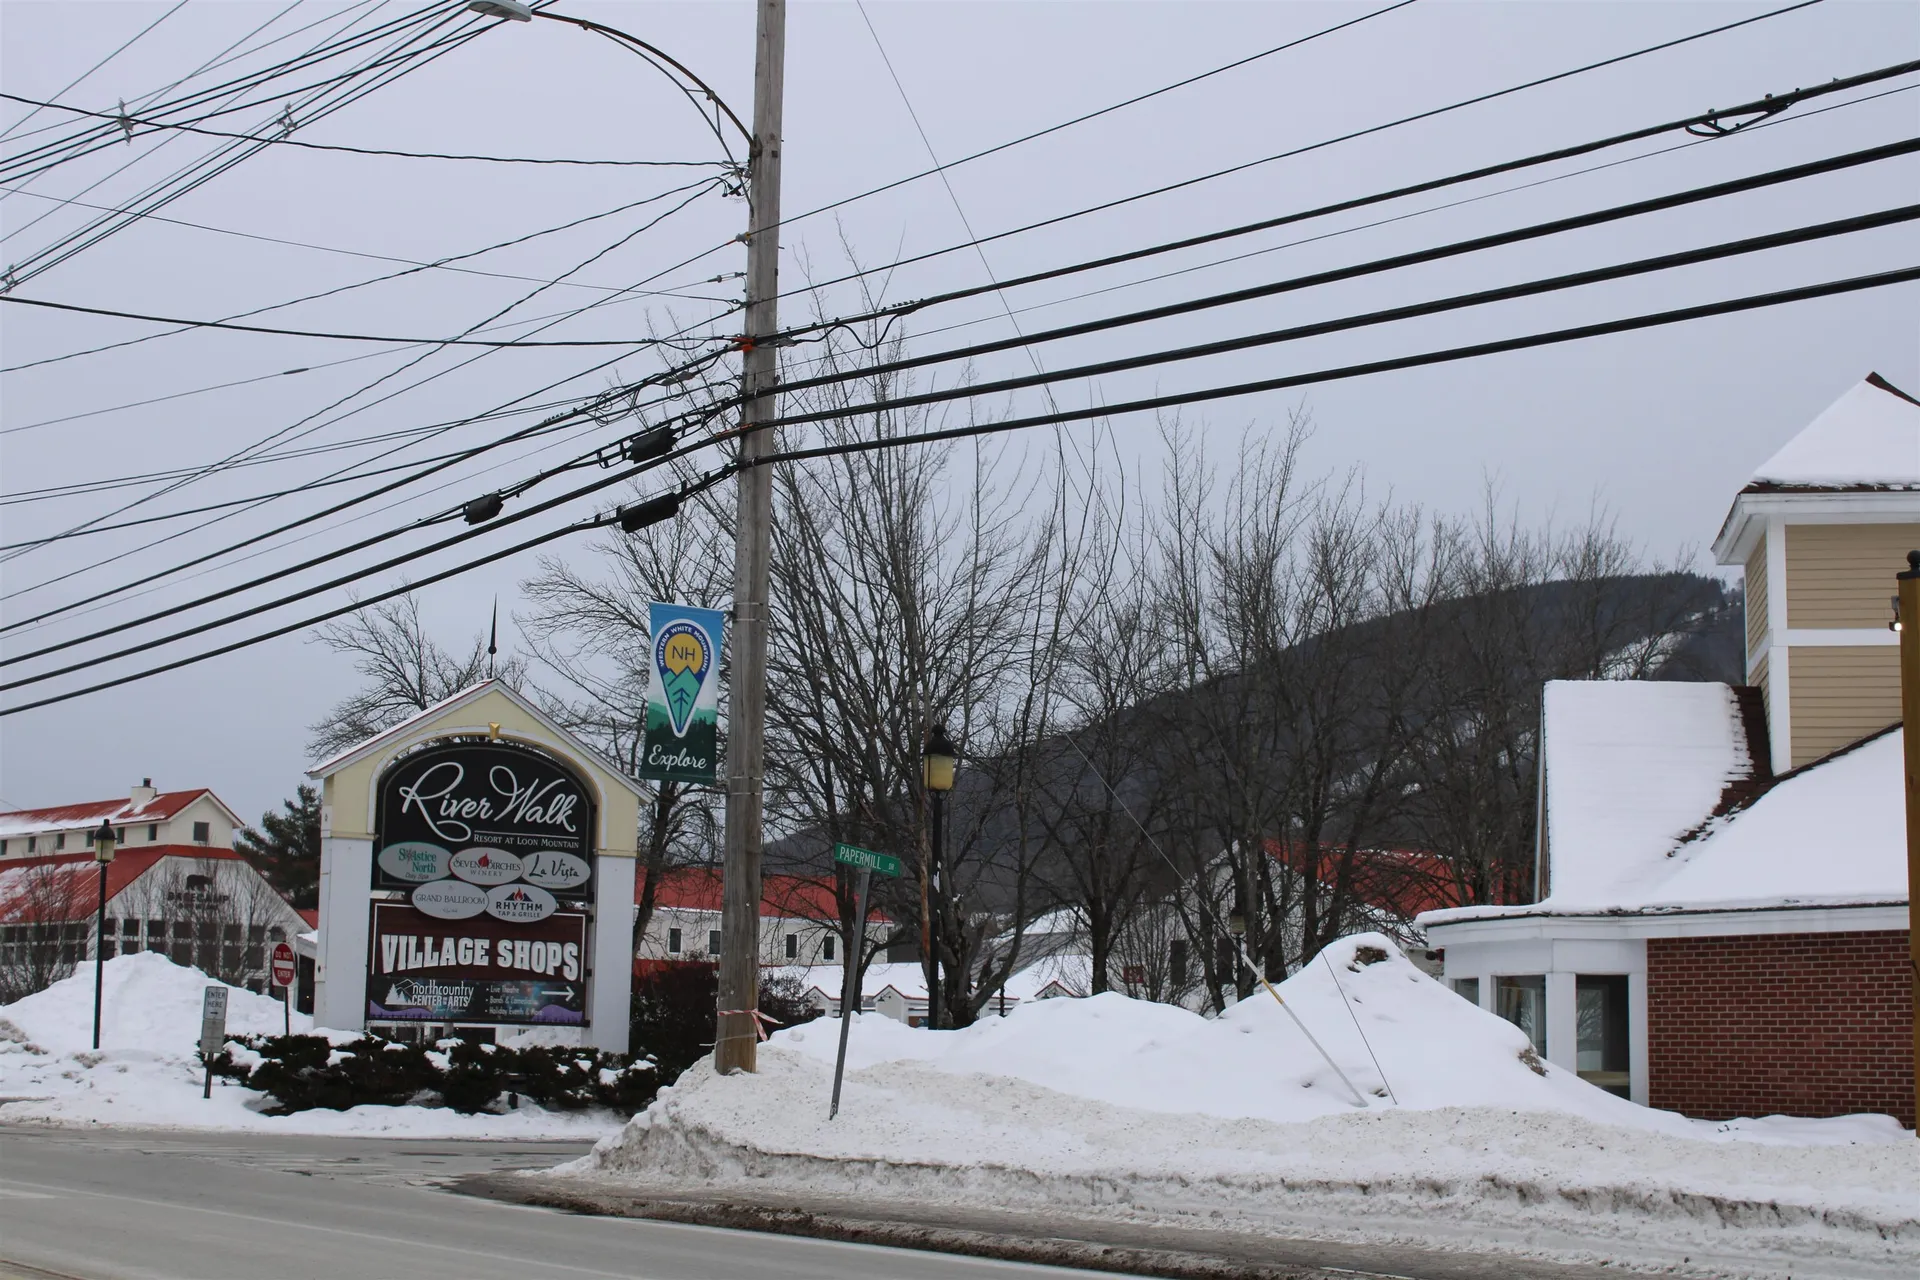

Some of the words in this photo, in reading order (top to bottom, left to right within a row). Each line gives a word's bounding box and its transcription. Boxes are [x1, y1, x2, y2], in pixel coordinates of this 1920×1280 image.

[658, 632, 670, 667] WESTERN
[670, 625, 693, 634] WHITE
[672, 645, 696, 662] NH
[648, 744, 708, 772] Explore
[399, 761, 493, 842] River
[489, 765, 578, 833] Walk
[840, 846, 882, 870] PAPERMILL
[412, 861, 437, 874] North
[528, 853, 547, 878] La
[552, 858, 580, 882] Vista
[415, 894, 442, 903] GRAND
[444, 895, 486, 905] BALLROOM
[495, 901, 543, 911] RHYTHM
[518, 911, 541, 919] GRILLE
[275, 950, 282, 959] DO
[283, 951, 292, 960] NOT
[381, 934, 490, 974] VILLAGE
[497, 939, 579, 982] SHOPS
[277, 970, 292, 978] ENTER
[206, 990, 225, 998] ENTER
[412, 979, 474, 1004] northcountry
[206, 1000, 223, 1008] HERE
[411, 994, 442, 1006] CENTER
[447, 995, 469, 1008] ARTS
